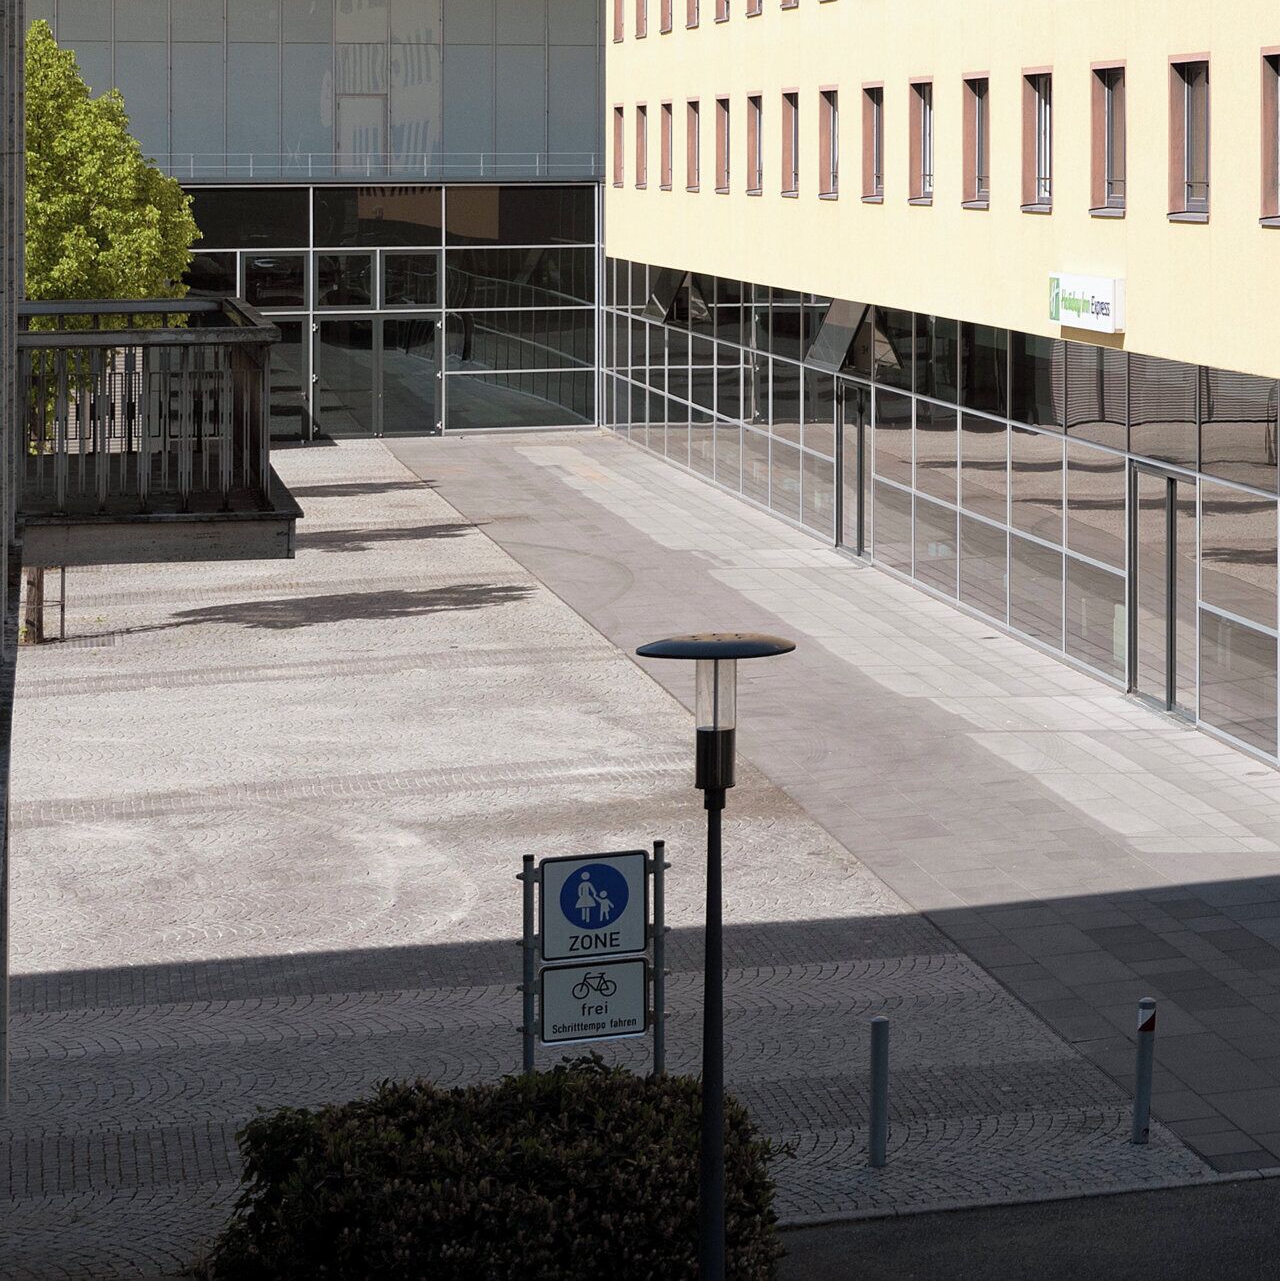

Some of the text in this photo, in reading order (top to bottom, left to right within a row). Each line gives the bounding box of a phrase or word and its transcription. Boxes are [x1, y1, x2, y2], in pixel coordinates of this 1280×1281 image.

[1091, 296, 1110, 320] Express
[569, 931, 620, 952] ZONE
[581, 1001, 608, 1017] frei
[552, 1017, 637, 1035] Schritttempo fahren
